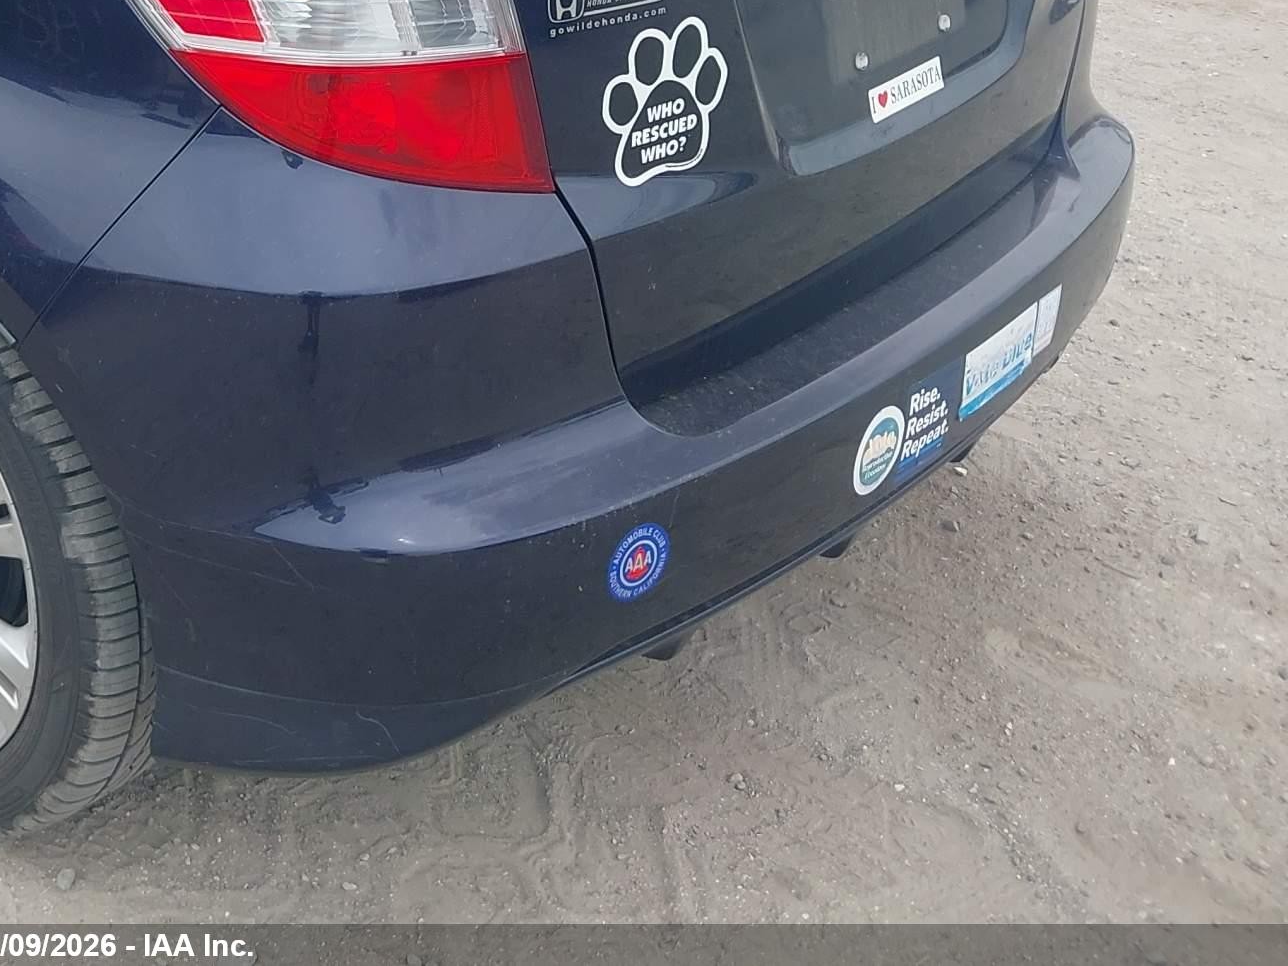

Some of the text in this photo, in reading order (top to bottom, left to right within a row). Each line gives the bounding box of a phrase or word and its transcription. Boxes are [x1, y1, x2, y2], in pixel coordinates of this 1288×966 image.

[549, 6, 667, 38] gowildehonda.com
[890, 65, 941, 104] SARASOTA
[646, 97, 686, 123] WHO
[631, 113, 698, 147] RESCUED
[640, 136, 687, 165] WHO?
[909, 386, 941, 417] Rise.
[905, 402, 949, 440] Resist.
[900, 420, 950, 462] Repeat.
[613, 527, 666, 564] AUTOMOBILE CLUB
[624, 550, 652, 573] AAA
[609, 553, 666, 598] SOUTHERN CALIFORNIA
